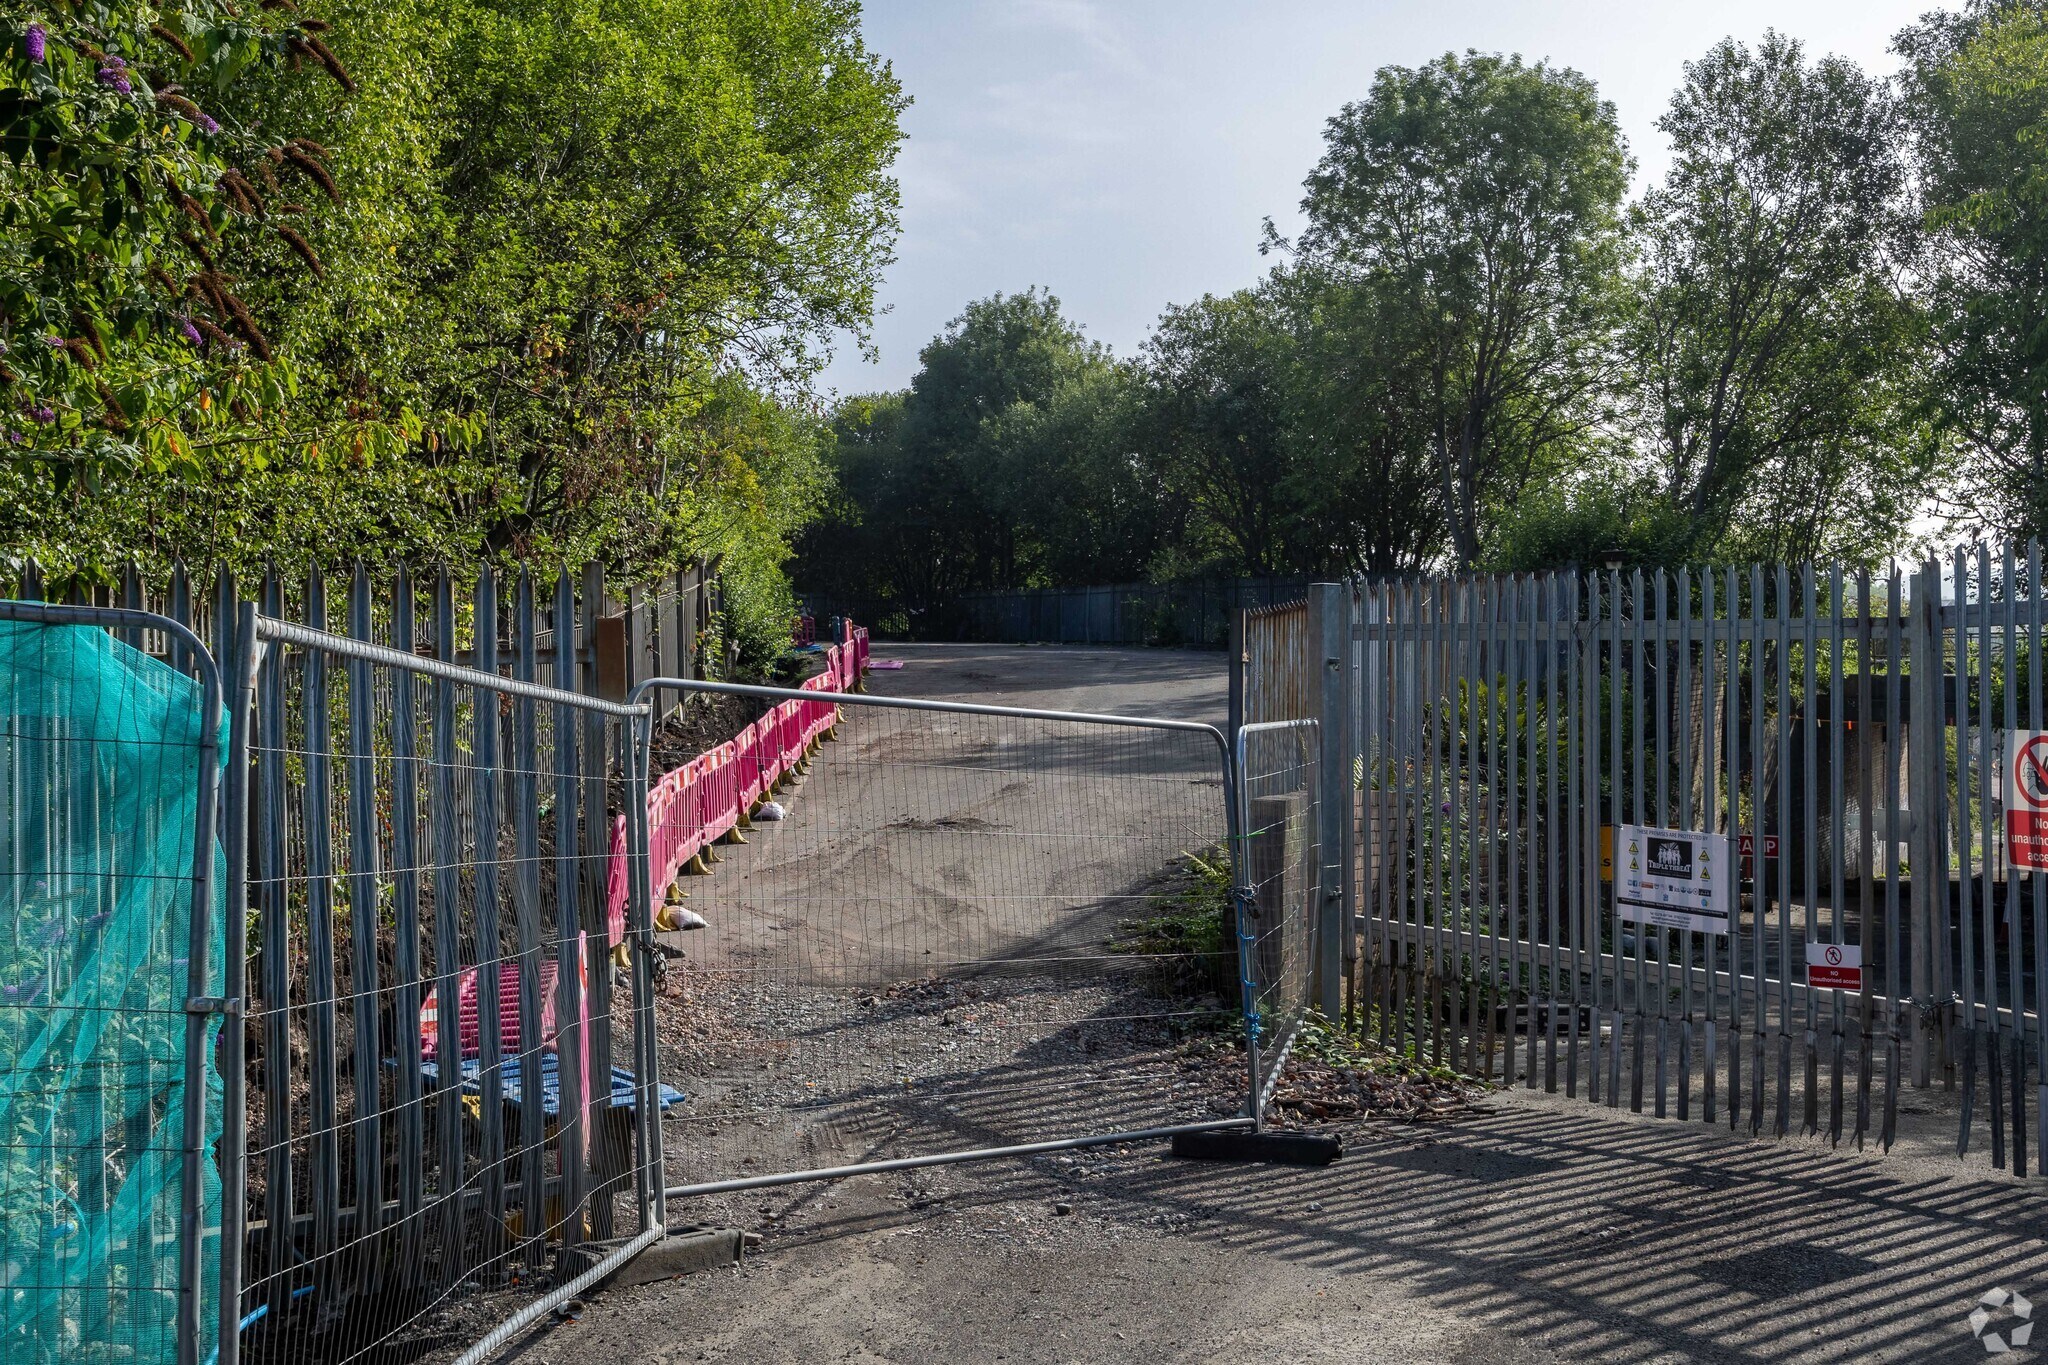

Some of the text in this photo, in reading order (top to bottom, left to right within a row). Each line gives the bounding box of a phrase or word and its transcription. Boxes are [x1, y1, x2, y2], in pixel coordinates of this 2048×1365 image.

[2035, 818, 2048, 829] No
[1649, 830, 1668, 838] PREMISES
[1678, 833, 1702, 841] PROTECTED
[1648, 860, 1691, 872] TRIPLE THREAT
